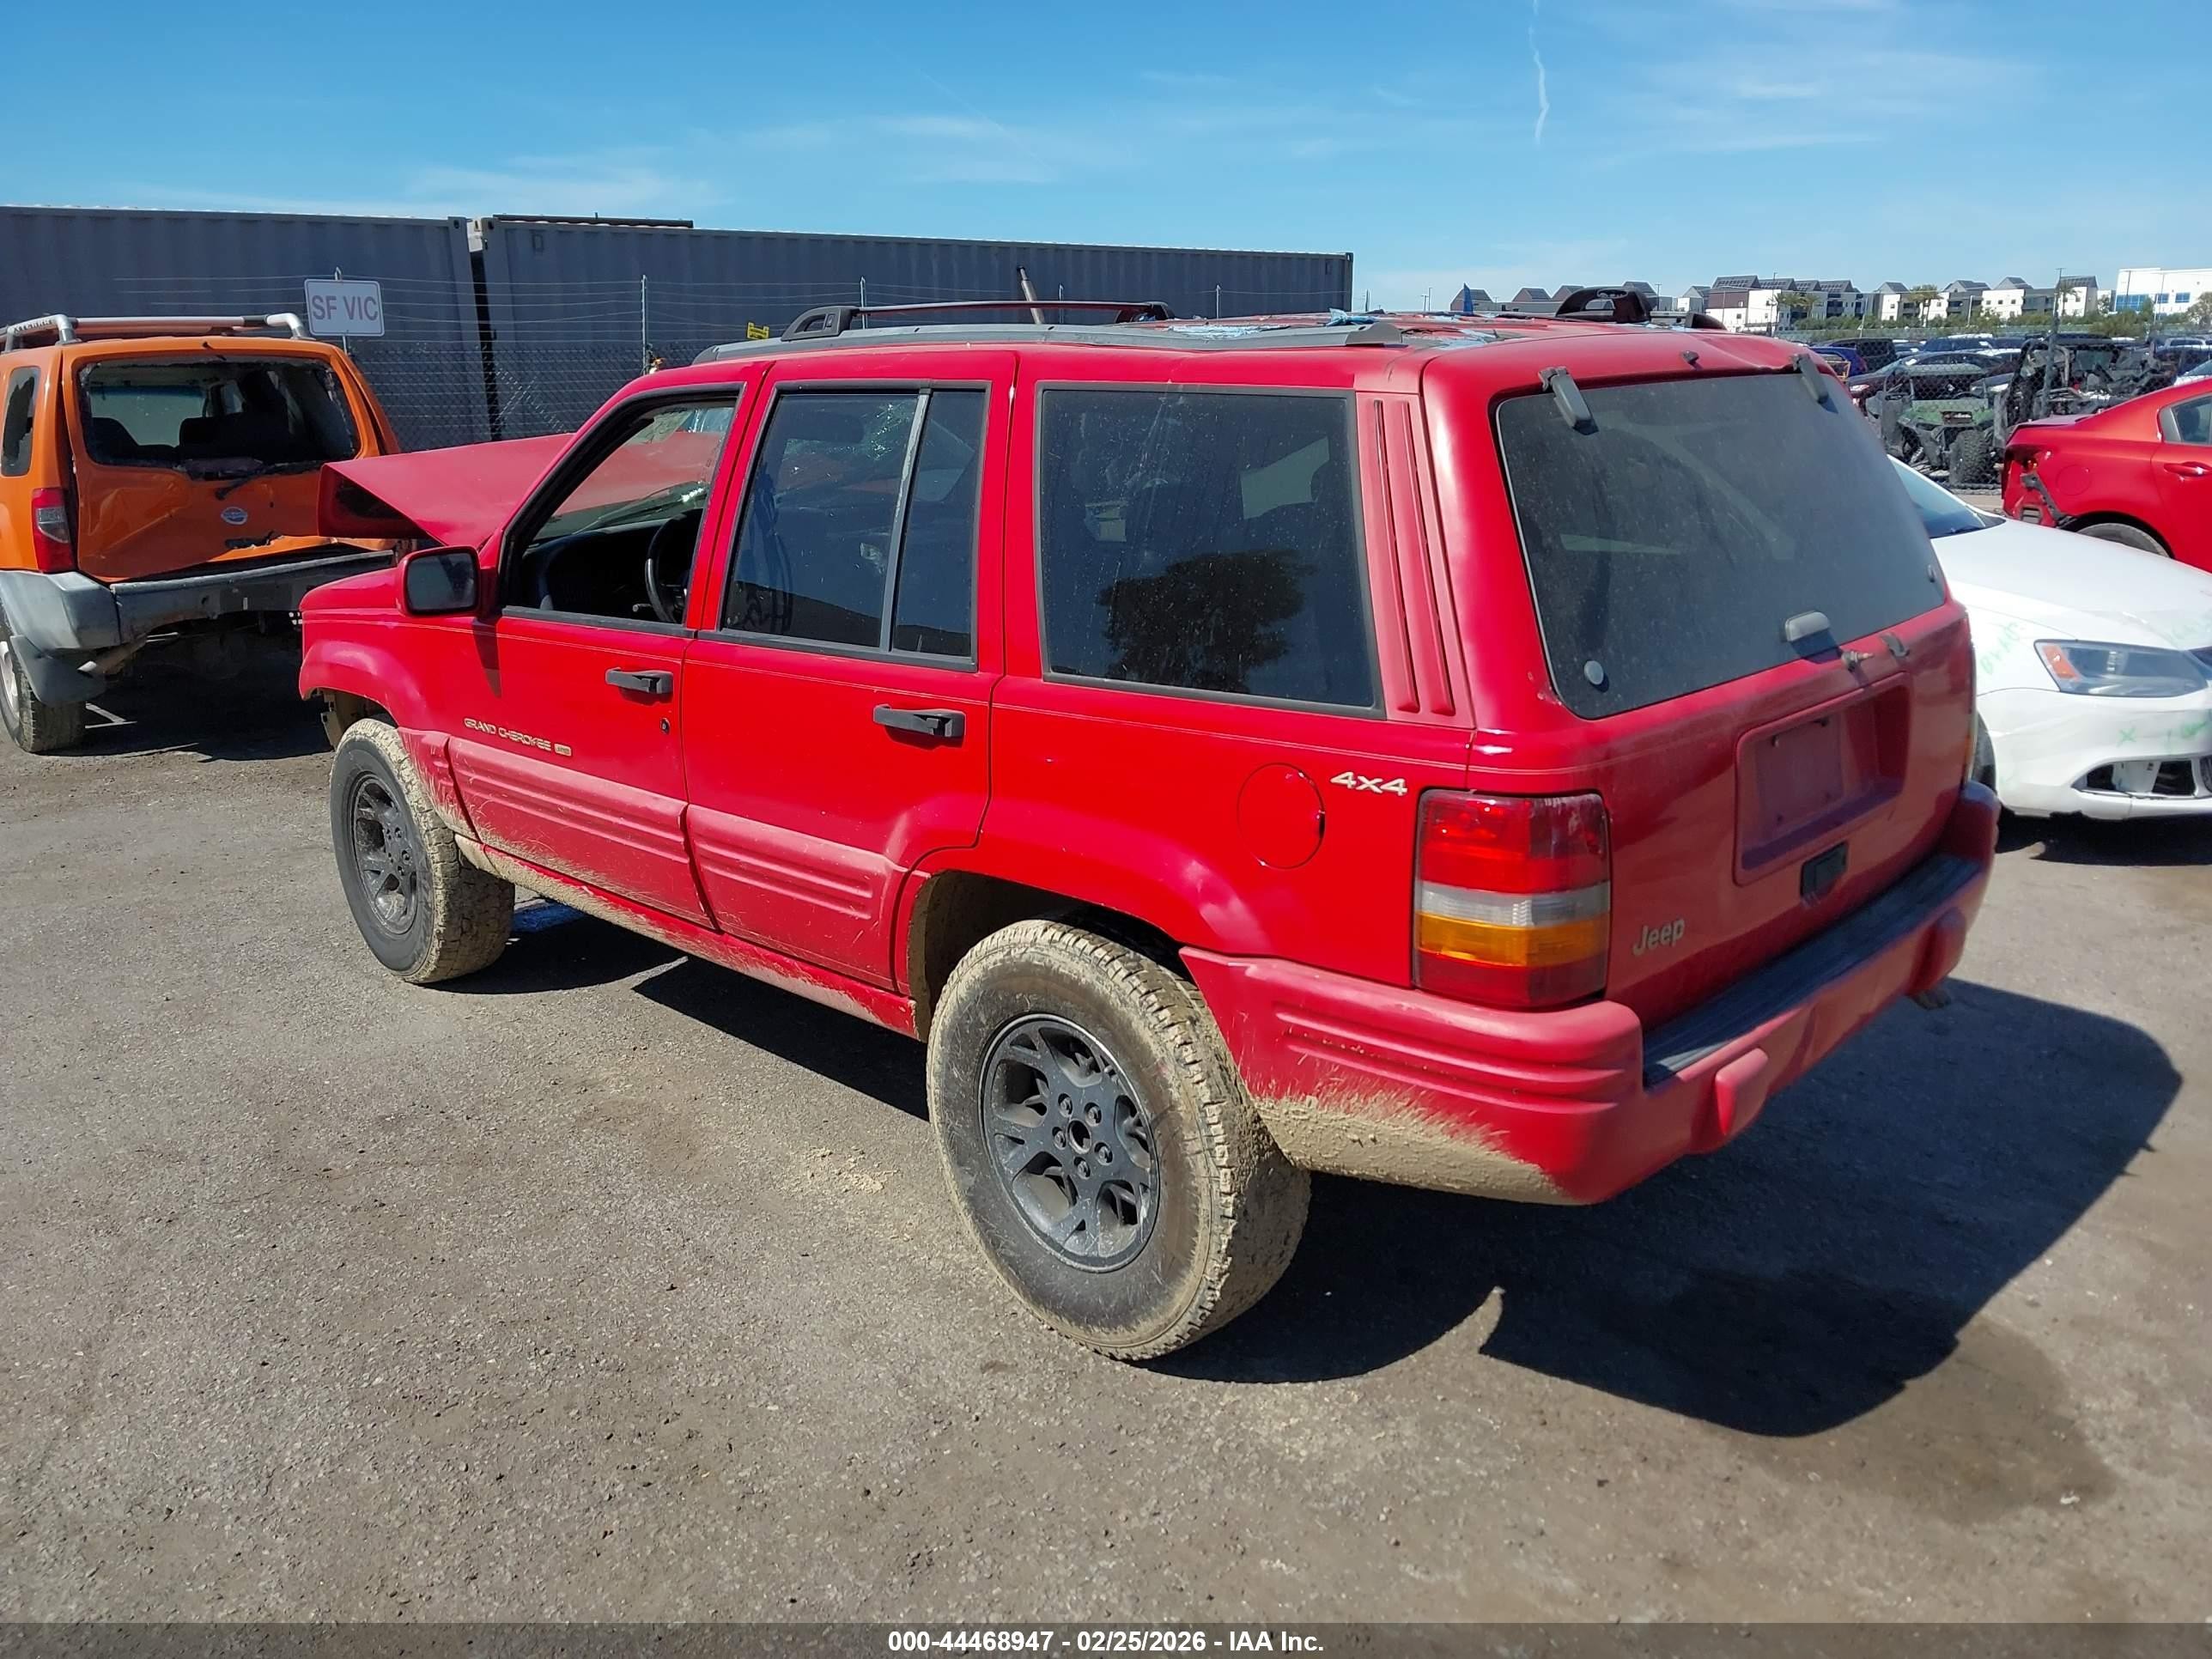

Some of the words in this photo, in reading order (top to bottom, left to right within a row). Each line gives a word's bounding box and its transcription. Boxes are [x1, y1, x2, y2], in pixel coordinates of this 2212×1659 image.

[312, 295, 337, 320] SF
[343, 295, 379, 321] VIC
[464, 718, 496, 735] GRAND
[498, 727, 552, 752] CHEROKEE
[1632, 918, 1685, 957] Jeep
